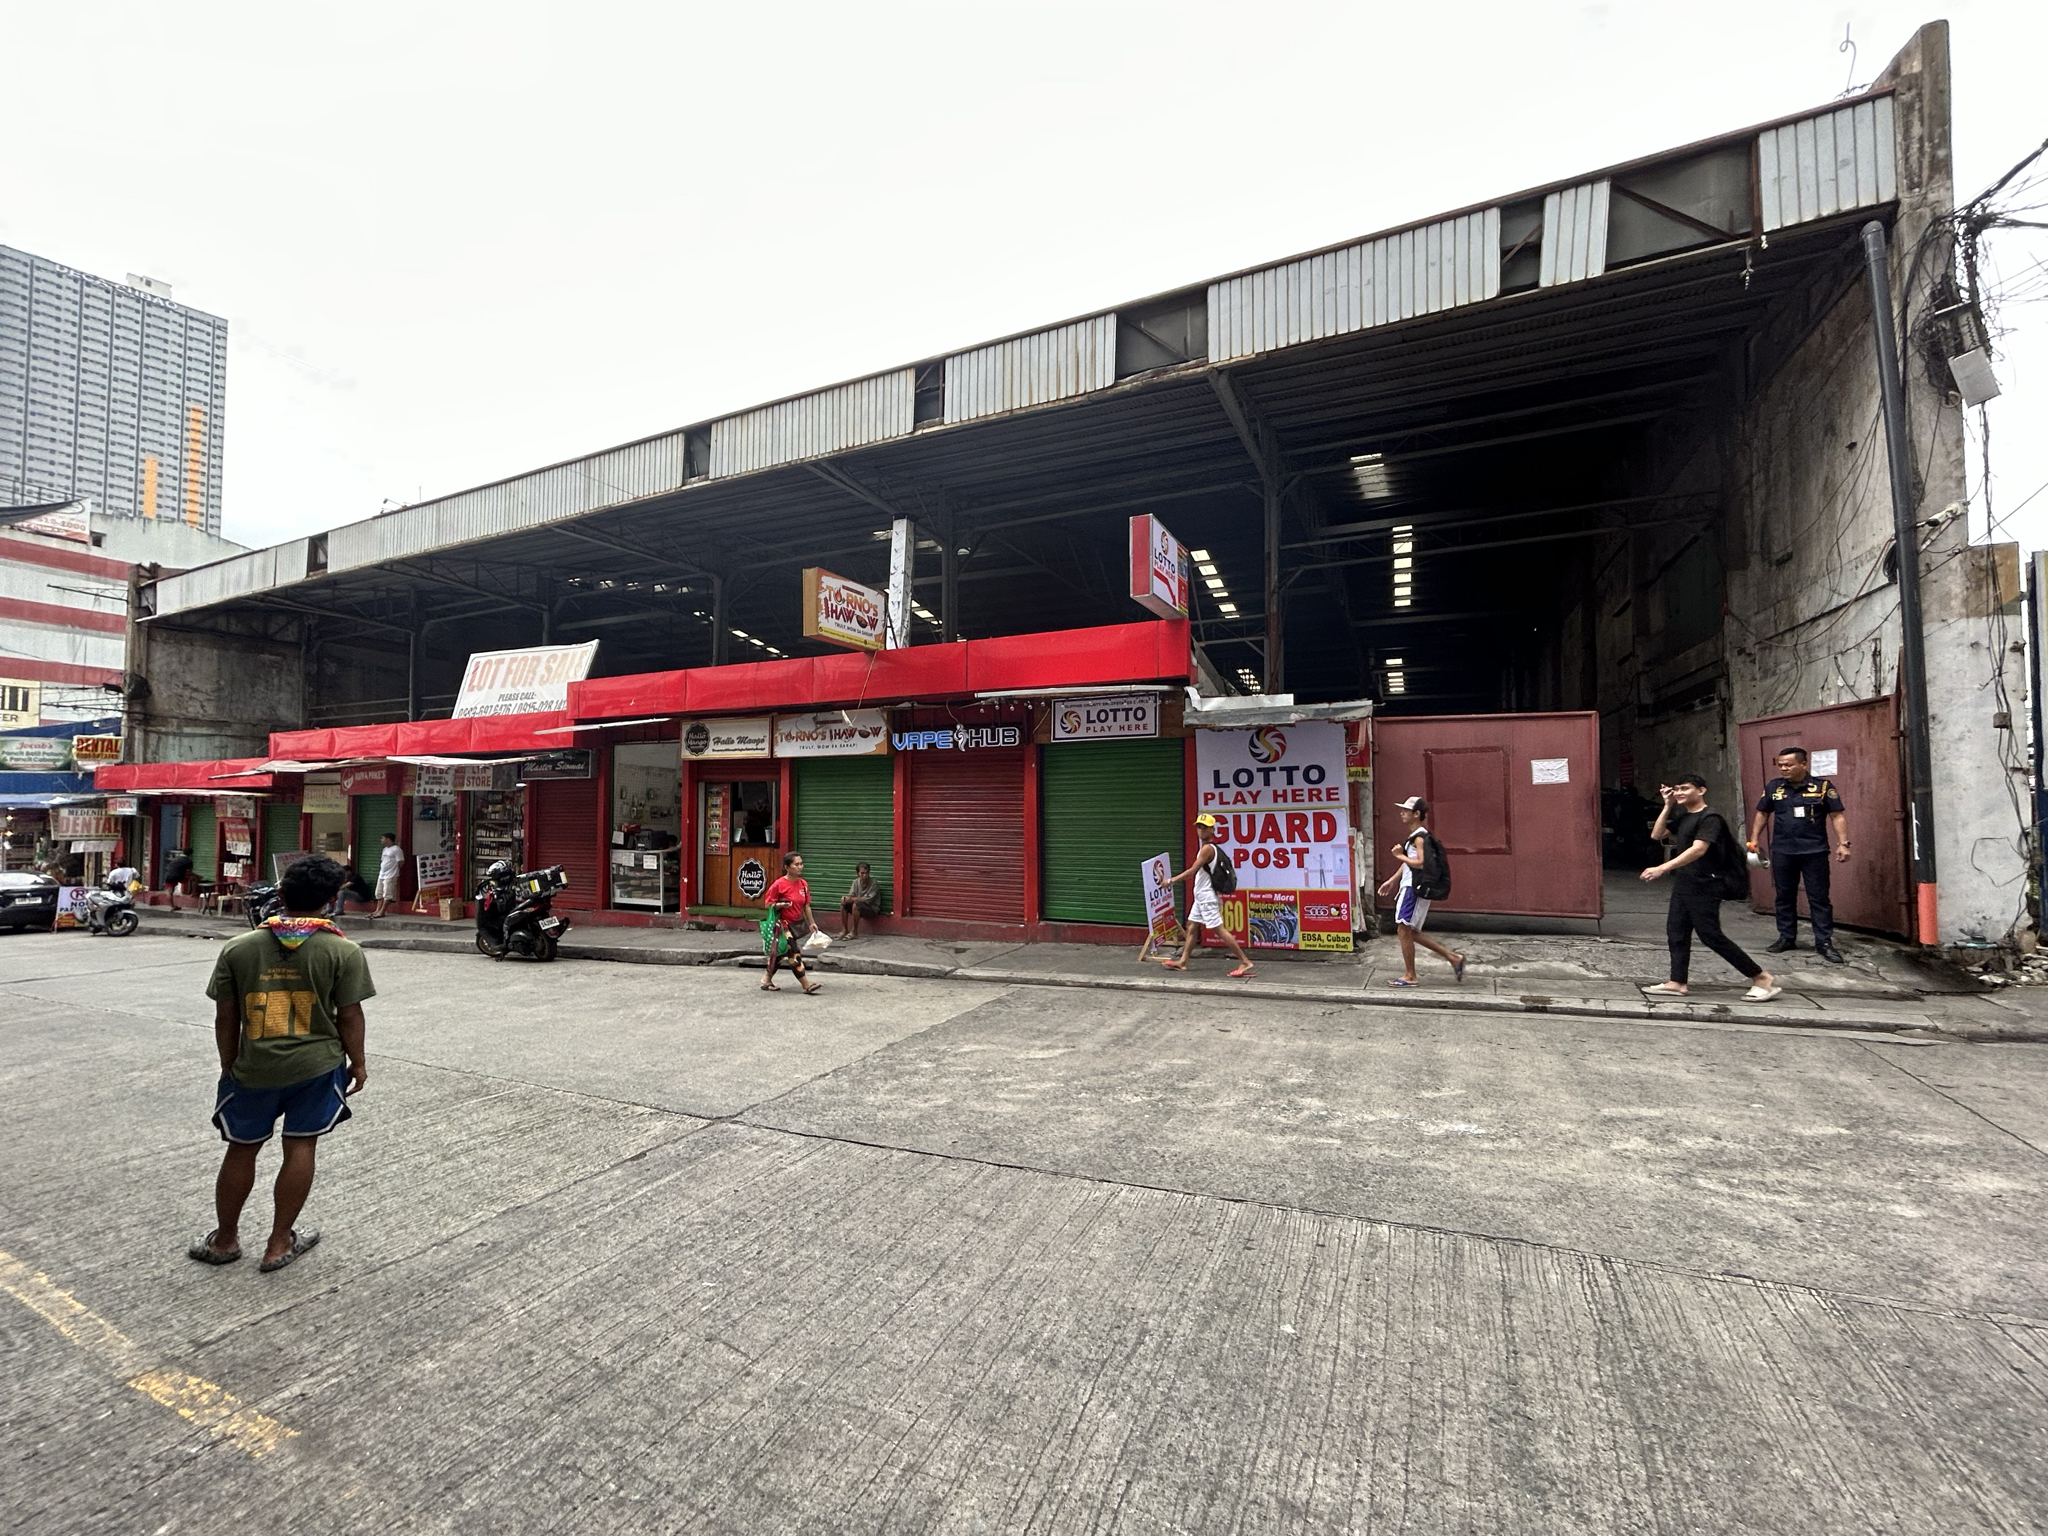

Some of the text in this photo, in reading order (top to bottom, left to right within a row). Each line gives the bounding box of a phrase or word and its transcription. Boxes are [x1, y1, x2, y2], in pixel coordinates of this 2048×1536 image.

[1154, 547, 1176, 574] LOTTO
[467, 648, 590, 693] LOT FOR SALE
[498, 692, 520, 702] PLEASE
[1086, 706, 1147, 724] LOTTO
[1086, 723, 1149, 734] PLAY HERE
[712, 737, 735, 746] Hallo
[892, 726, 1021, 751] VAPE HUB
[77, 738, 120, 753] DENTAL
[524, 760, 586, 772] Master Siomai
[466, 776, 491, 787] STORE
[1213, 764, 1326, 789] LOTTO
[1203, 786, 1340, 806] PLAY HERE
[59, 816, 120, 834] DENTAL
[1213, 811, 1338, 845] GUARD
[1233, 847, 1310, 869] POST
[740, 878, 763, 888] Mango
[1273, 893, 1295, 902] More
[1250, 901, 1285, 911] Motorcycle
[1250, 910, 1275, 920] Parking
[1301, 933, 1351, 943] EDSA, Cubao
